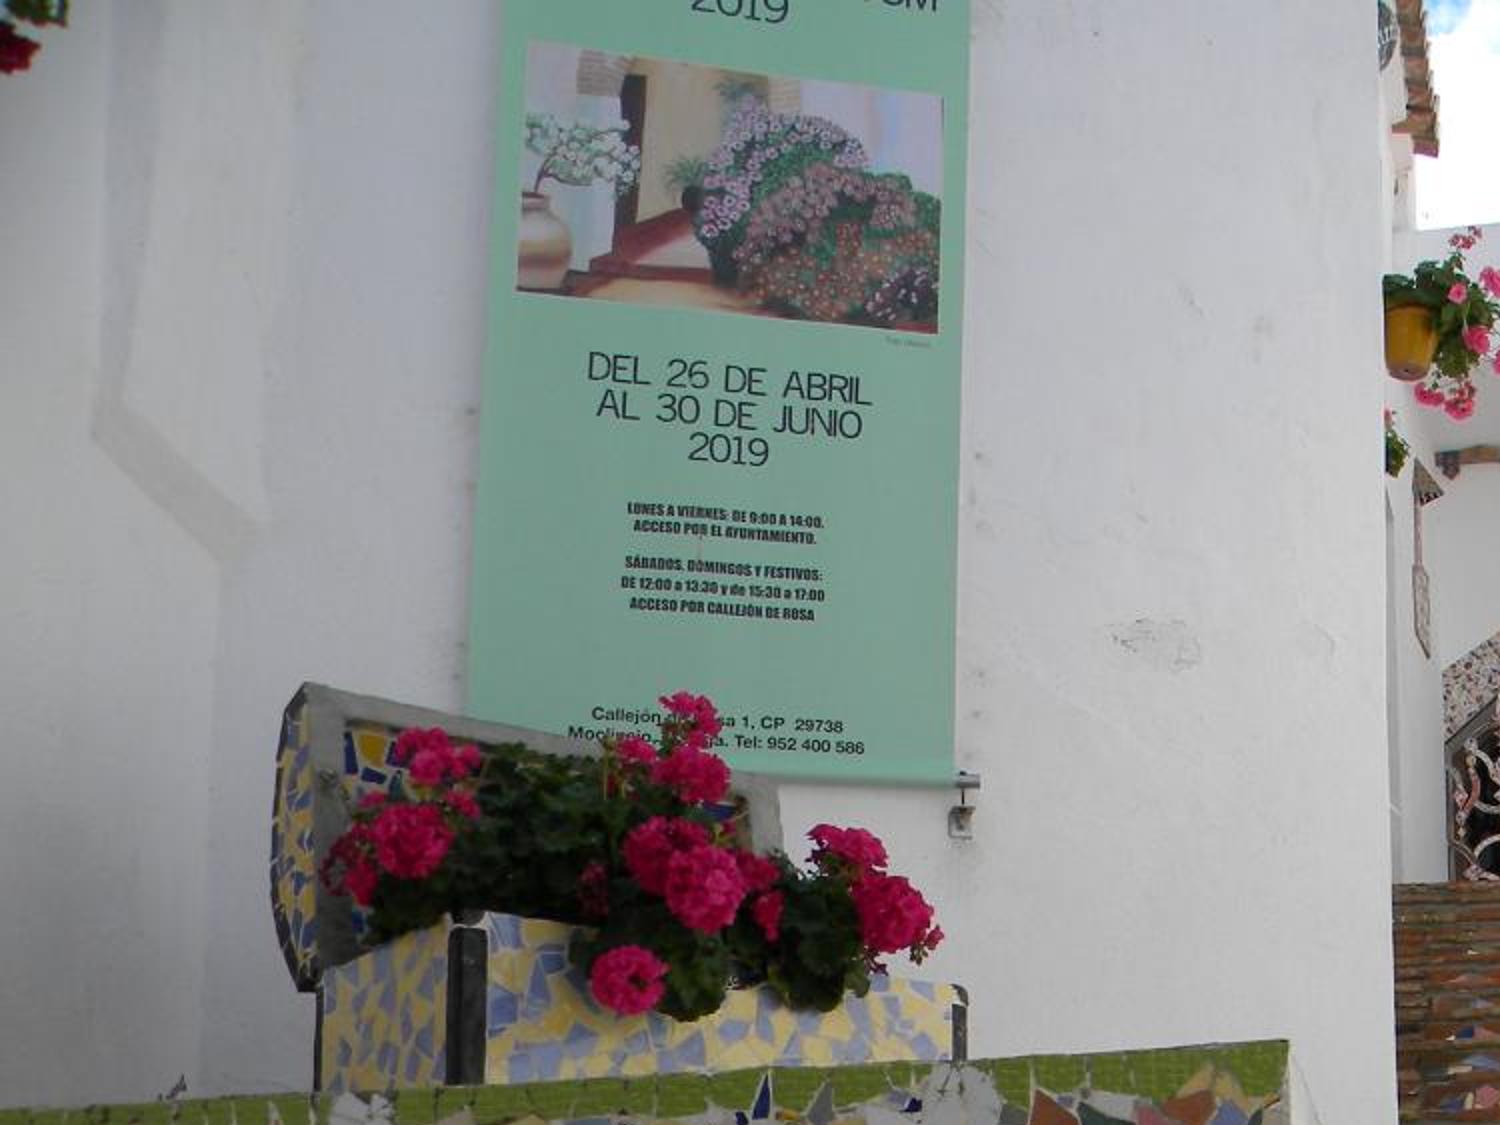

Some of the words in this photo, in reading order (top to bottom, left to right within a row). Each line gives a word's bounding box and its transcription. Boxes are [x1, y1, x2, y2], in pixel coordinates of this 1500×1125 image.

[587, 351, 651, 385] DEL
[667, 358, 710, 389] 26
[724, 365, 767, 397] DE
[782, 370, 872, 406] ABRIL
[596, 389, 640, 420] AL
[655, 393, 700, 424] 30
[713, 399, 757, 431] DE
[773, 405, 863, 439] JUNIO
[688, 431, 769, 467] 2019
[627, 501, 665, 516] LUNES
[666, 504, 675, 517] A
[731, 510, 746, 523] DE
[750, 511, 776, 525] 9:00
[779, 513, 787, 526] A
[633, 519, 680, 534] ACCESO
[683, 523, 708, 536] POR
[710, 524, 722, 537] EL
[687, 559, 752, 576] DOMINGOS
[754, 564, 763, 577] Y
[764, 565, 823, 581] FESTIVOS:
[621, 576, 636, 589] DE
[639, 577, 671, 591] 12:00
[674, 581, 682, 591] a
[685, 579, 718, 594] 13:30
[720, 583, 728, 596] y
[730, 583, 745, 596] de
[749, 585, 781, 599] 15:30
[784, 588, 792, 599] a
[795, 588, 825, 602] 17:00
[629, 597, 678, 612] ACCESO
[680, 600, 705, 613] POR
[707, 601, 762, 618] CALLEJÓN
[765, 606, 779, 619] DE
[782, 607, 815, 621] ROSA
[591, 706, 661, 725] Callejón
[761, 715, 785, 729] CP
[794, 718, 844, 733] 29738
[734, 734, 762, 749] Tel:
[767, 737, 797, 751] 952
[801, 739, 831, 752] 400
[835, 741, 865, 755] 586
